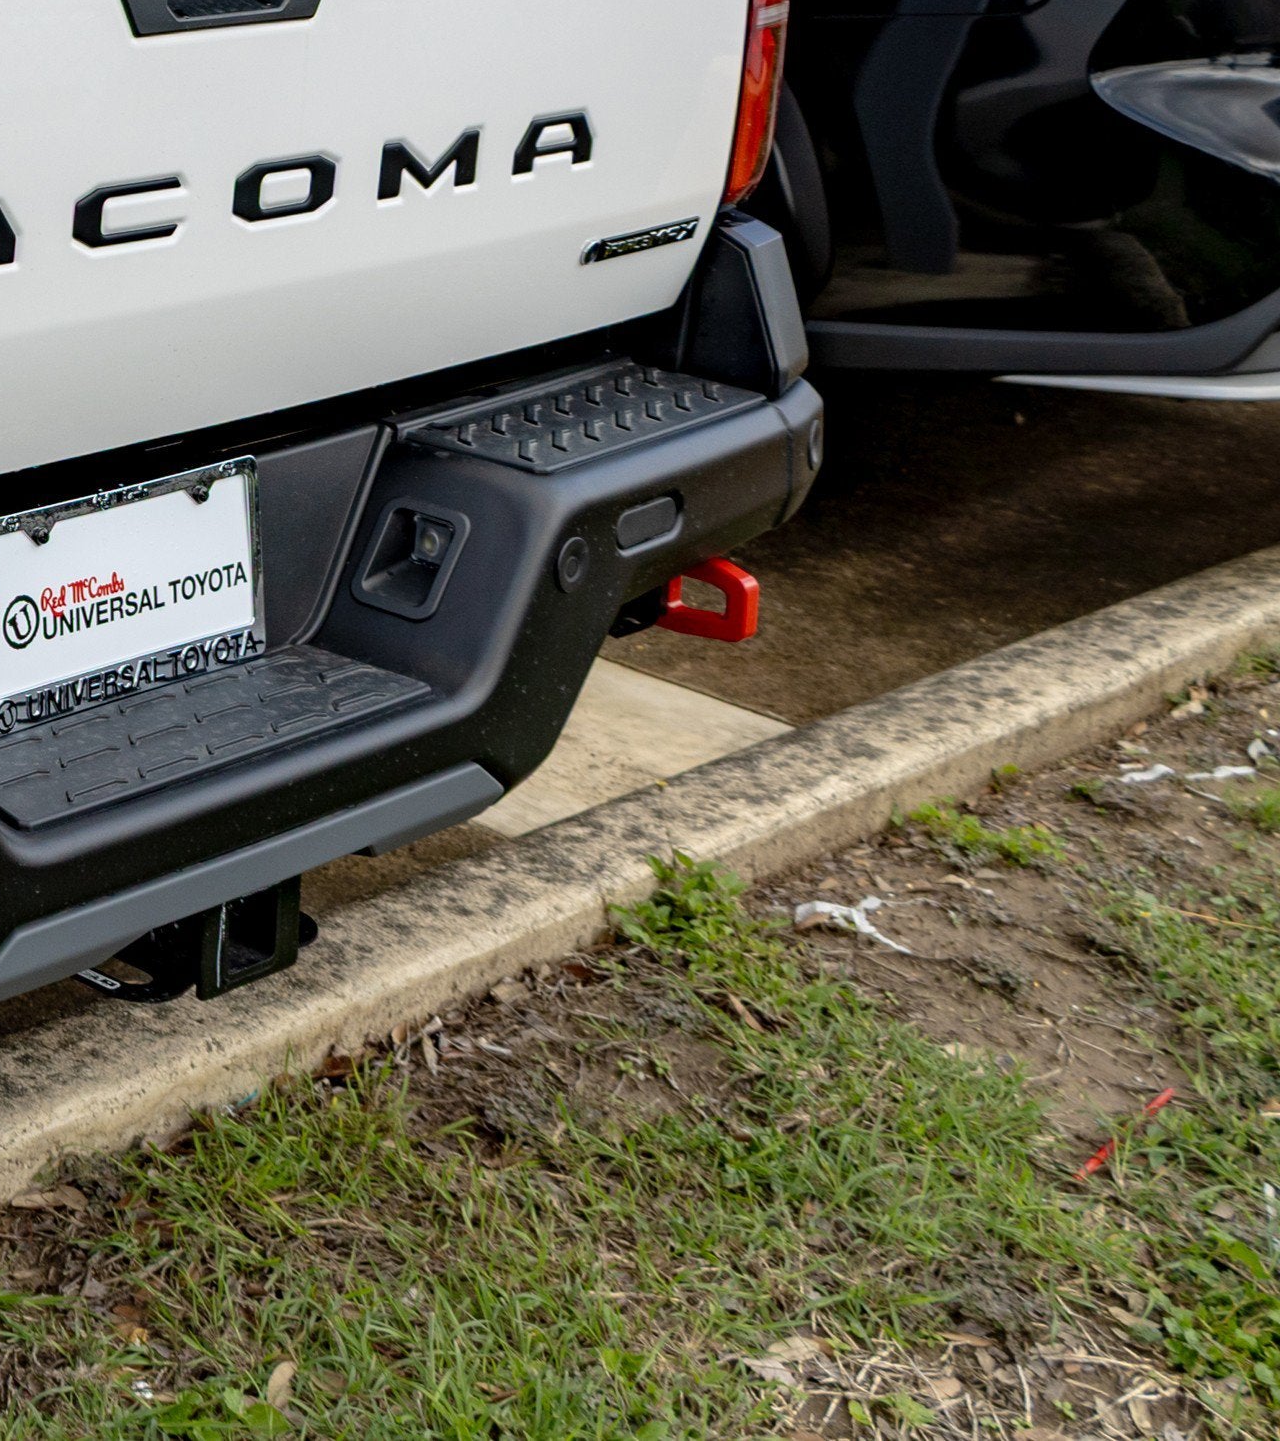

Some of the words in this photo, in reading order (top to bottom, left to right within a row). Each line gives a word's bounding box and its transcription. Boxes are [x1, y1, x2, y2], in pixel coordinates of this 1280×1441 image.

[40, 586, 66, 617] Red
[69, 571, 125, 604] McCombs
[42, 585, 166, 640] UNIVERSAL
[168, 561, 248, 605] TOYOTA
[25, 657, 167, 722] UNIVERSAL
[168, 630, 258, 676] TOYOTA
